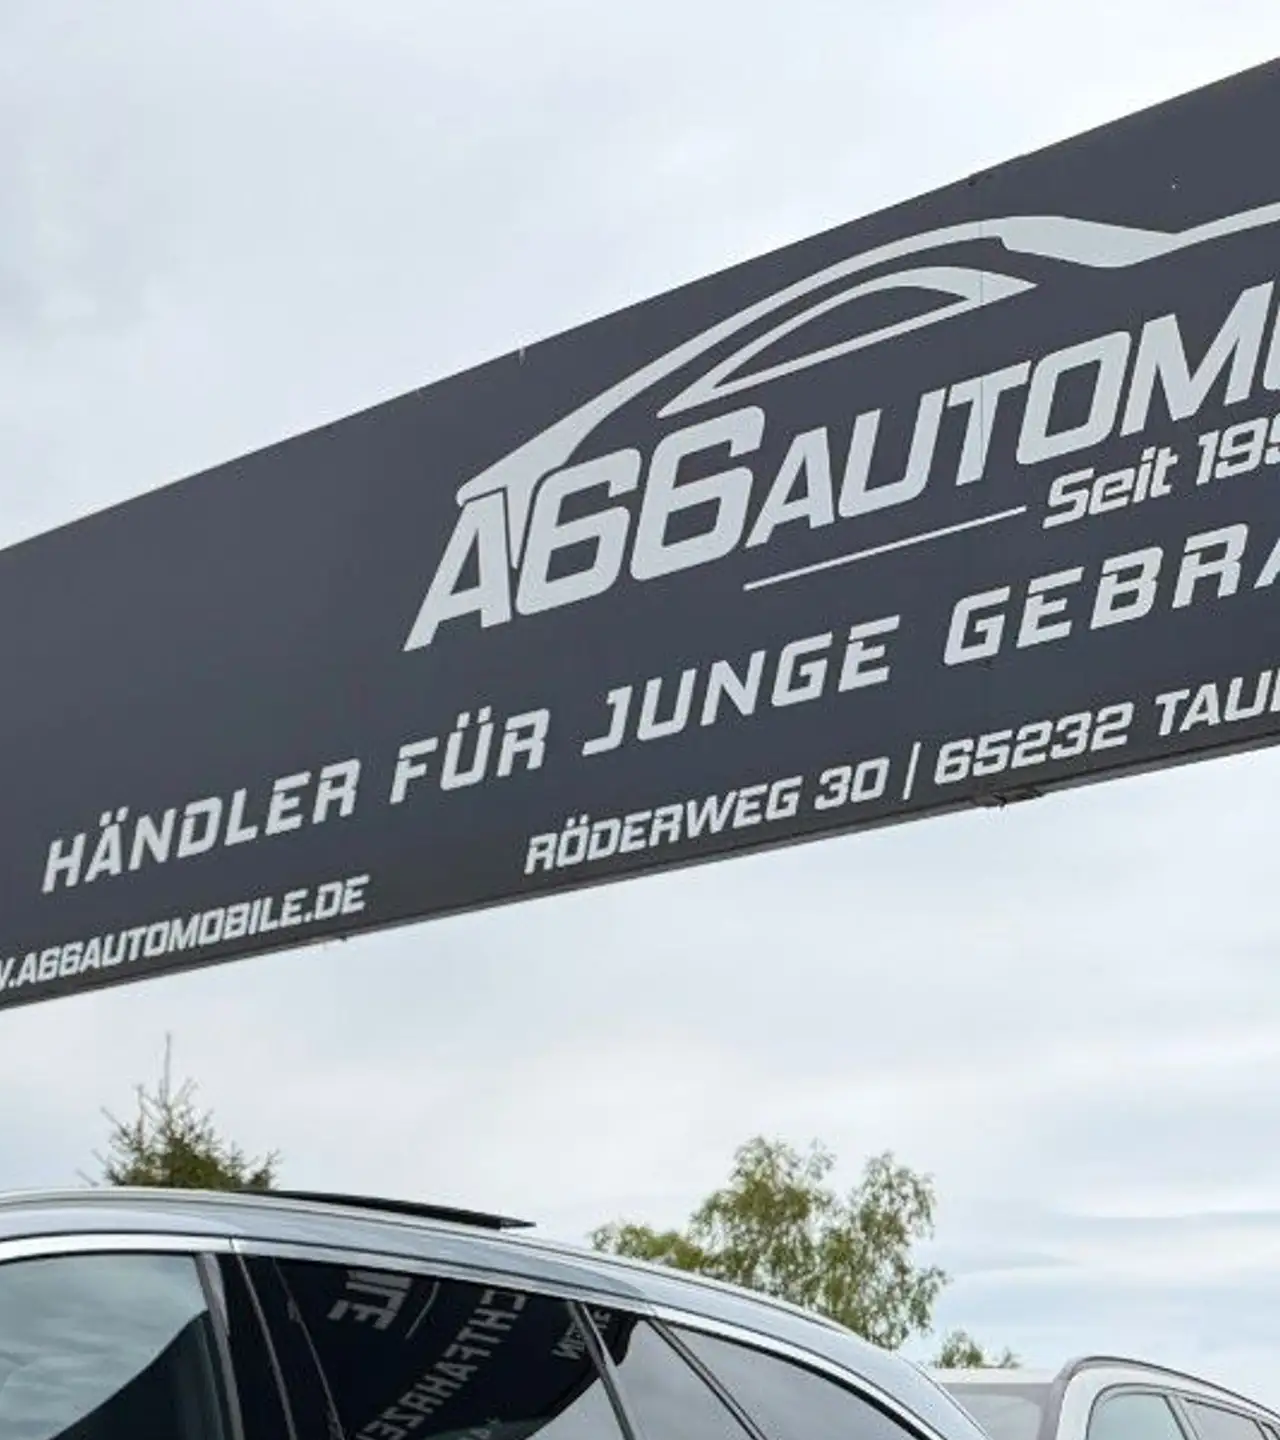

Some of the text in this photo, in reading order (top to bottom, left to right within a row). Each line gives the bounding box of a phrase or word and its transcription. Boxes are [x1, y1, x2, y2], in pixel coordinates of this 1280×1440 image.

[403, 281, 1280, 652] A66AUTOM
[1042, 446, 1179, 529] Seit
[41, 758, 361, 894] HÄNDLER
[390, 705, 550, 805] FÜR
[581, 614, 901, 757] JUNGE
[523, 775, 803, 876] RÖDERWEG
[814, 756, 890, 810] 30
[934, 701, 1135, 785] 65232
[1152, 668, 1280, 737] TAU
